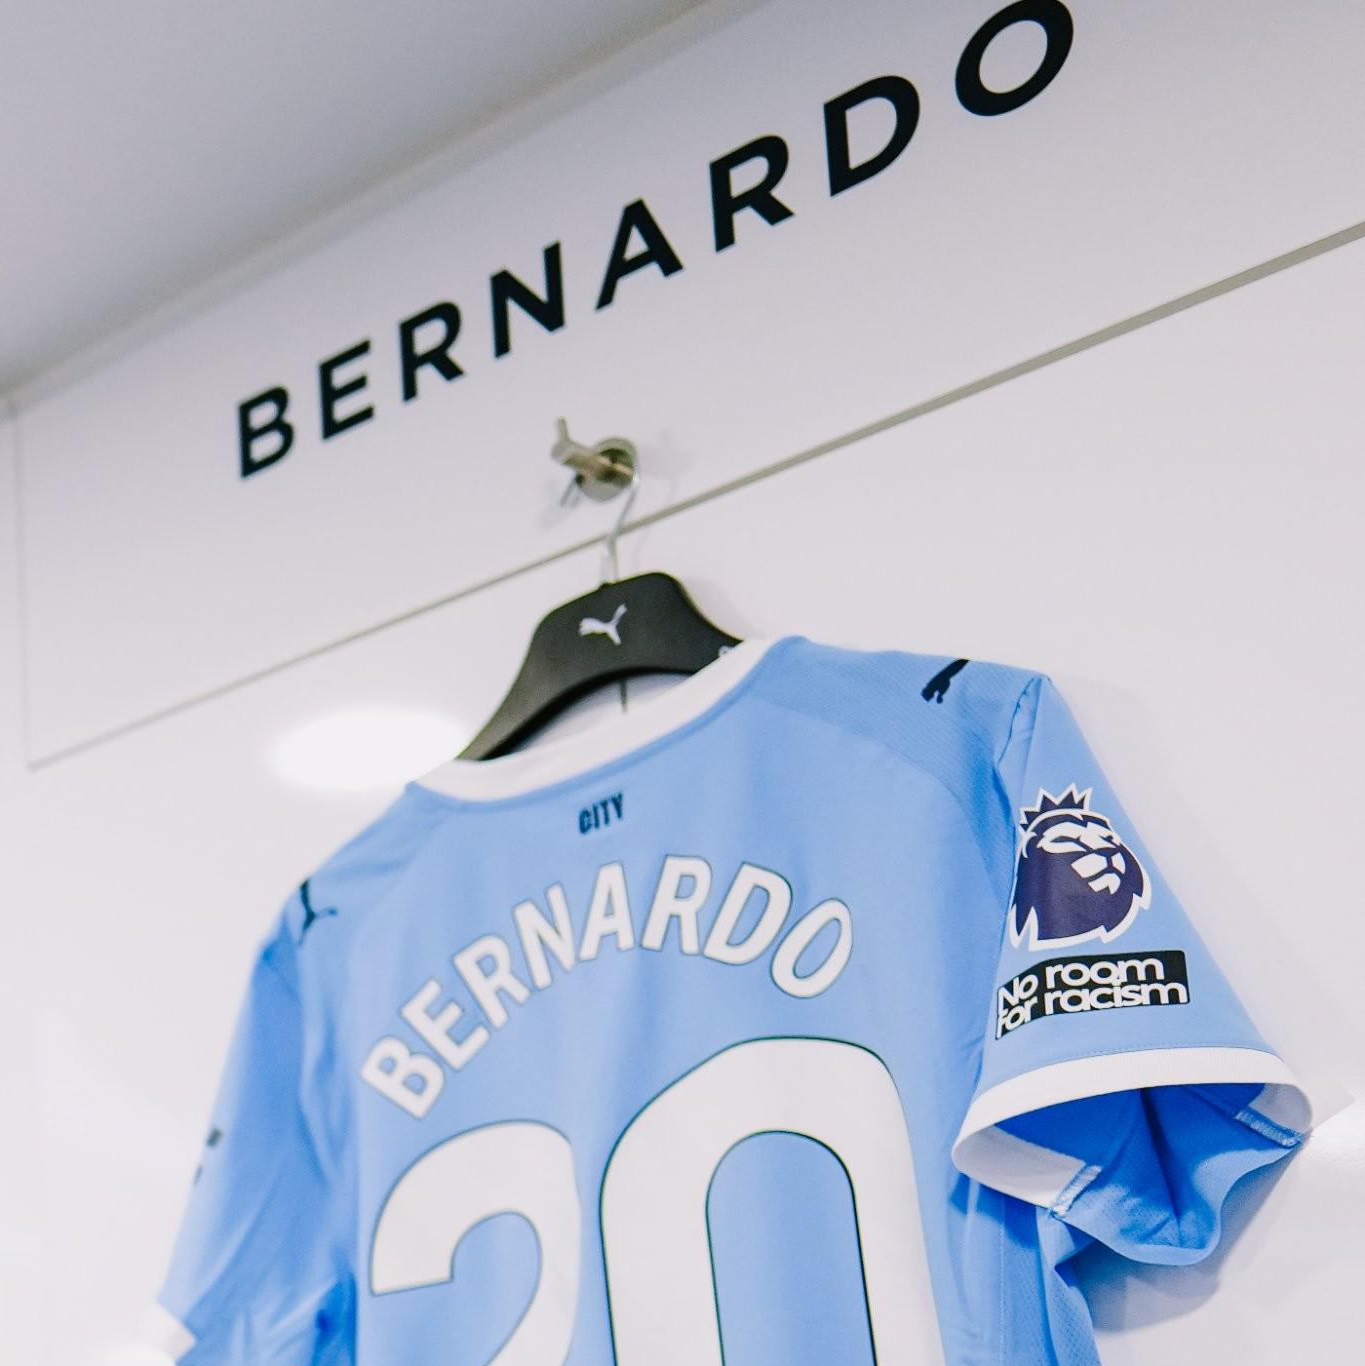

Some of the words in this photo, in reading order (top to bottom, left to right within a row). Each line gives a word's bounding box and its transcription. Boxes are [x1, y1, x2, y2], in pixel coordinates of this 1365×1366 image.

[238, 0, 1075, 480] BERNARDO
[578, 791, 624, 835] CITY
[360, 854, 854, 1121] BERNARDO
[997, 995, 1038, 1039] for
[1044, 981, 1189, 1016] racism
[998, 974, 1039, 1013] No
[1044, 957, 1165, 990] room
